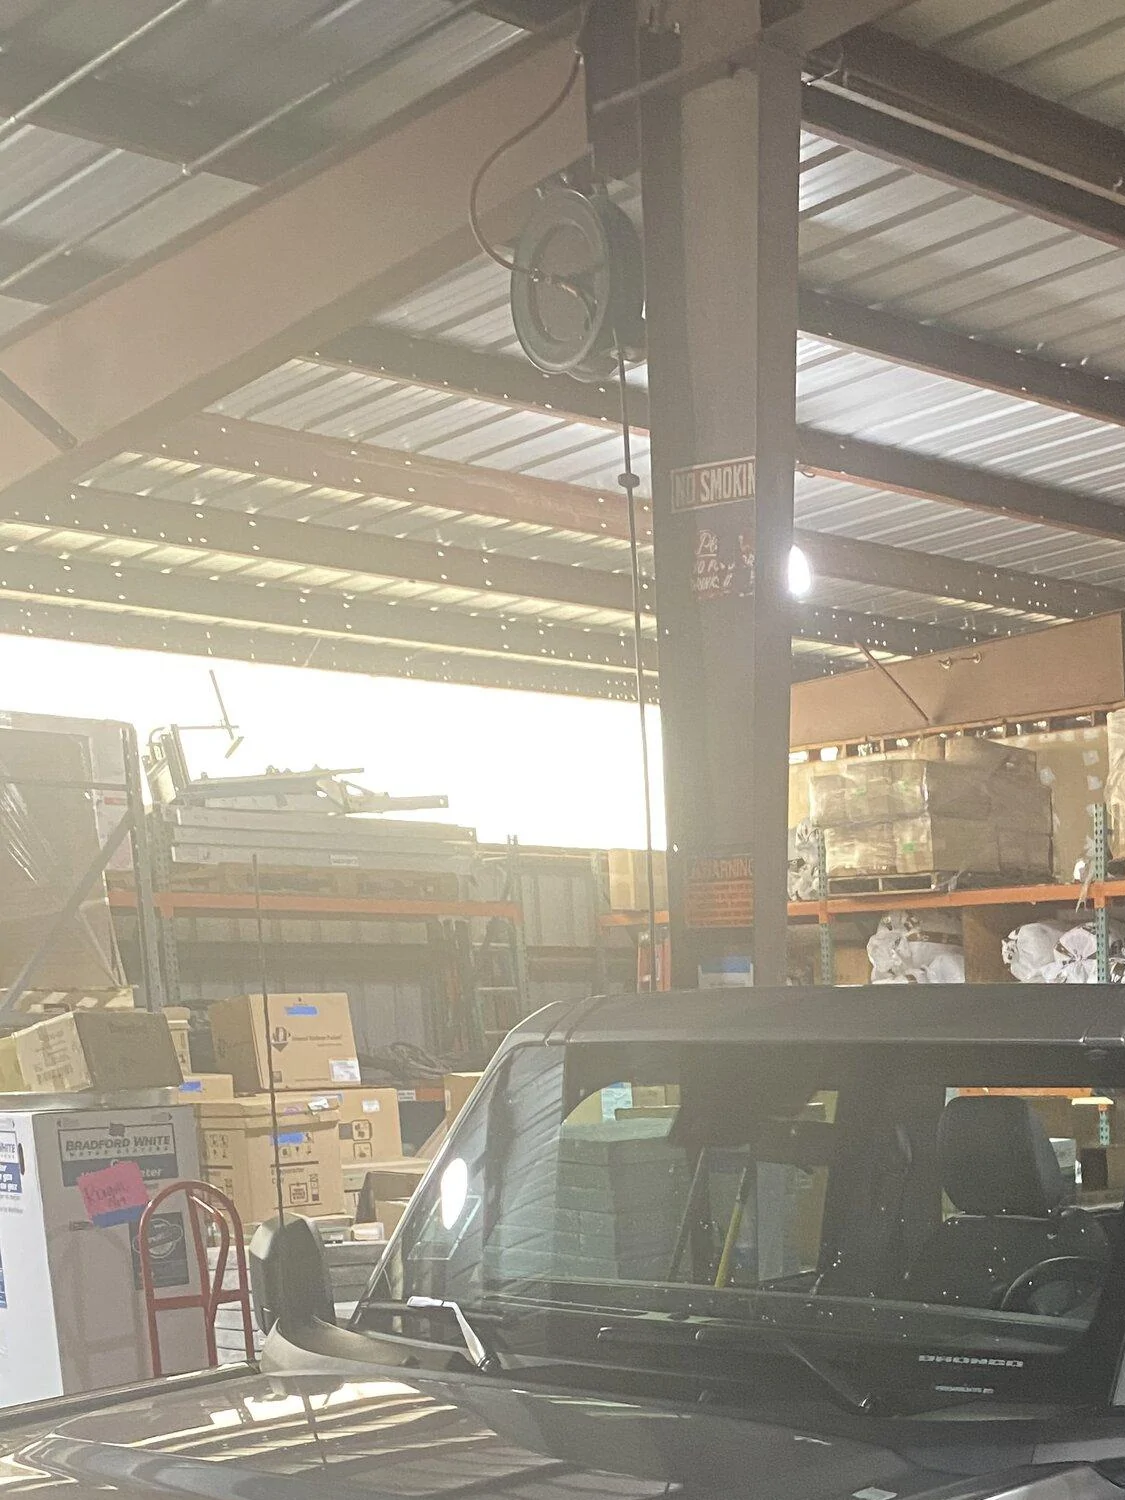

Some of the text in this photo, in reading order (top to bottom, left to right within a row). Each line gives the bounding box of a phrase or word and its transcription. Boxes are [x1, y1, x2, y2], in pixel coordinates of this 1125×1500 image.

[674, 462, 756, 507] NO SMOKIN
[65, 1134, 171, 1152] BRADFORD WHITE
